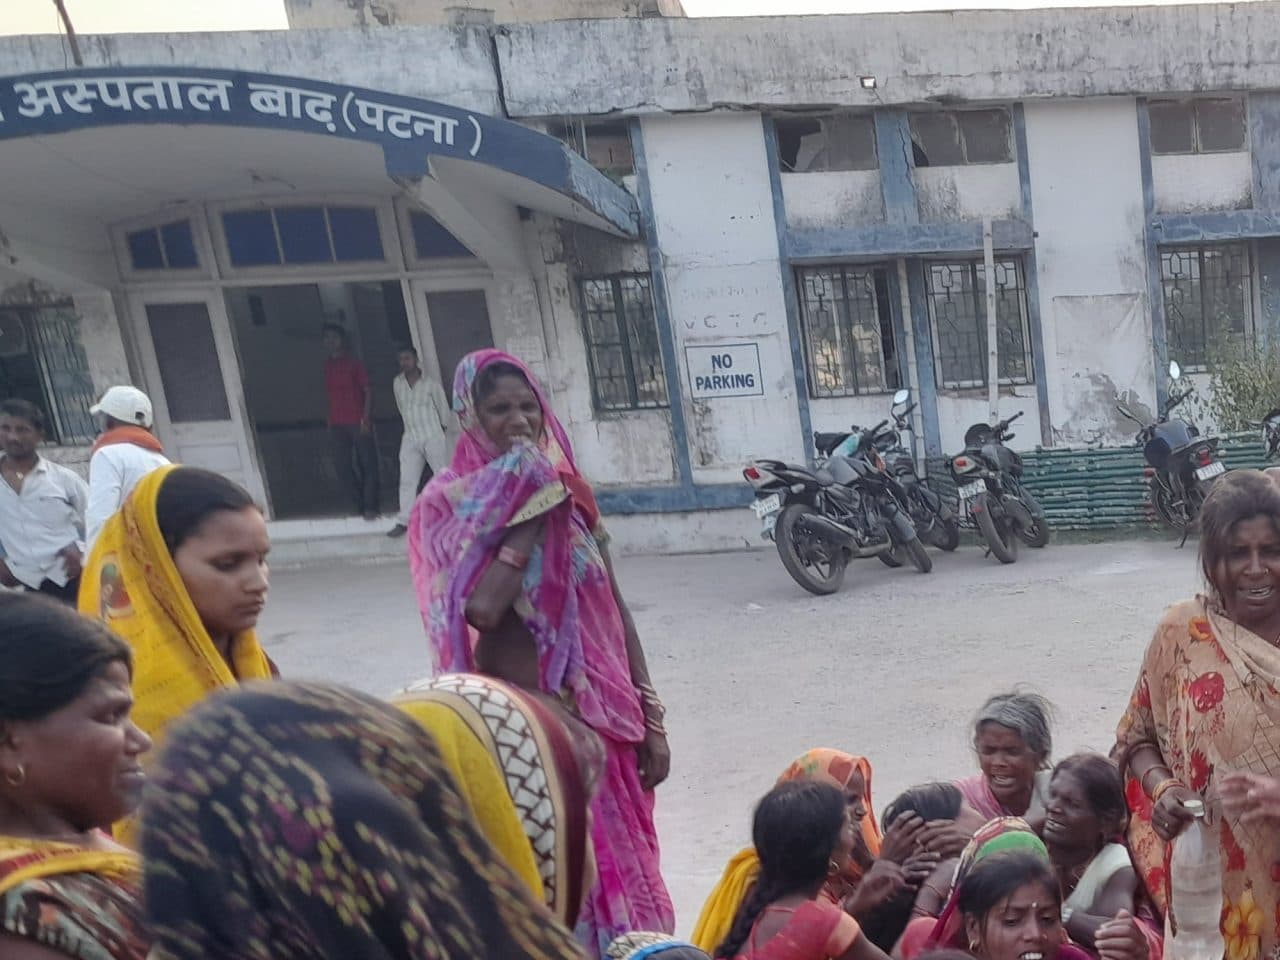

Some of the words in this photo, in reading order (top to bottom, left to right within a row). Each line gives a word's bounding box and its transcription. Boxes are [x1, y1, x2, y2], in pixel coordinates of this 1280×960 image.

[13, 76, 234, 118] अस्पताल
[248, 82, 337, 133] बाढ़
[711, 353, 733, 369] NO
[695, 373, 755, 391] PARKING
